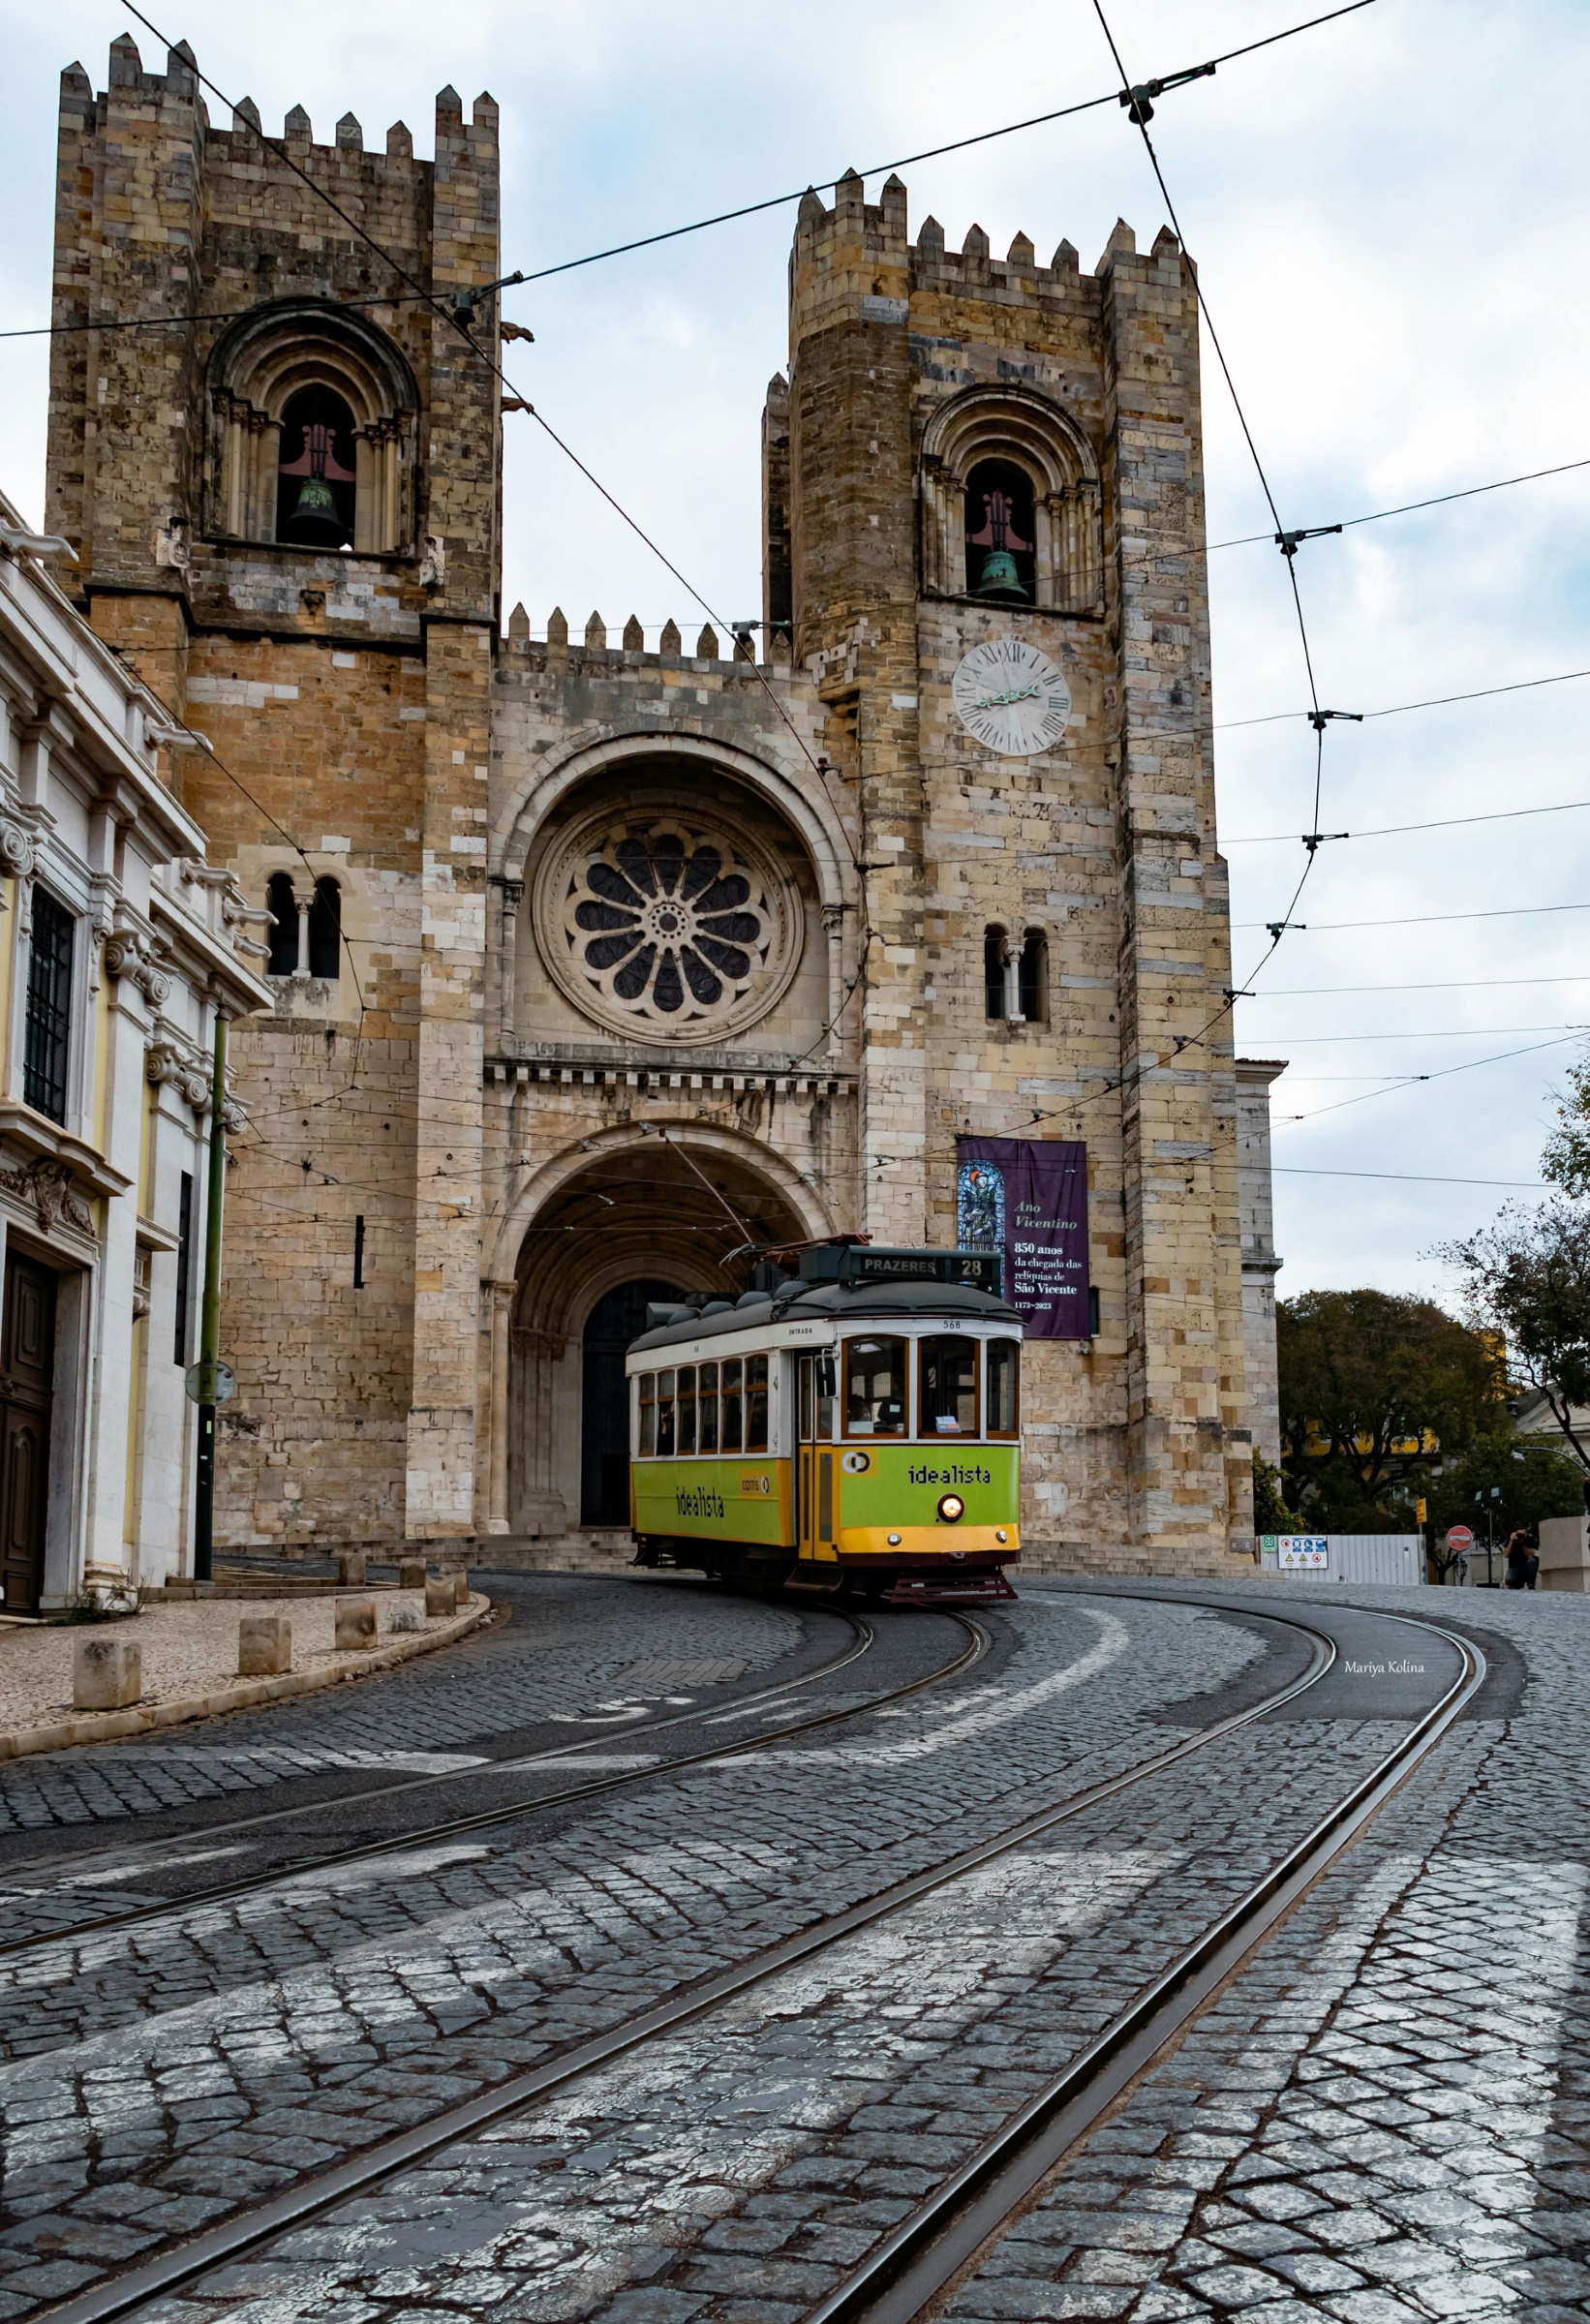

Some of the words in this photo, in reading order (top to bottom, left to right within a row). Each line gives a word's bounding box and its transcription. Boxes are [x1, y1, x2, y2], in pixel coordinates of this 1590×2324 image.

[979, 645, 998, 666] XI
[1003, 642, 1021, 664] XII
[1028, 652, 1040, 670] I
[962, 660, 982, 680] X
[1043, 673, 1061, 687] II
[1049, 696, 1069, 710] III
[1014, 1200, 1041, 1213] Ano
[1015, 1215, 1078, 1230] Vicentino
[1014, 1241, 1035, 1254] 850
[1037, 1245, 1063, 1256] anos
[865, 1258, 936, 1275] PRAZERES
[962, 1260, 982, 1276] 28
[1014, 1256, 1026, 1268] da
[1027, 1257, 1064, 1270] chegada
[1066, 1258, 1082, 1269] das
[1014, 1269, 1053, 1283] relíquias
[1054, 1271, 1065, 1281] de
[1014, 1281, 1035, 1294] São
[1037, 1282, 1078, 1295] Vicente
[943, 1320, 961, 1330] 568
[908, 1465, 991, 1483] idealista
[676, 1485, 724, 1518] idealista
